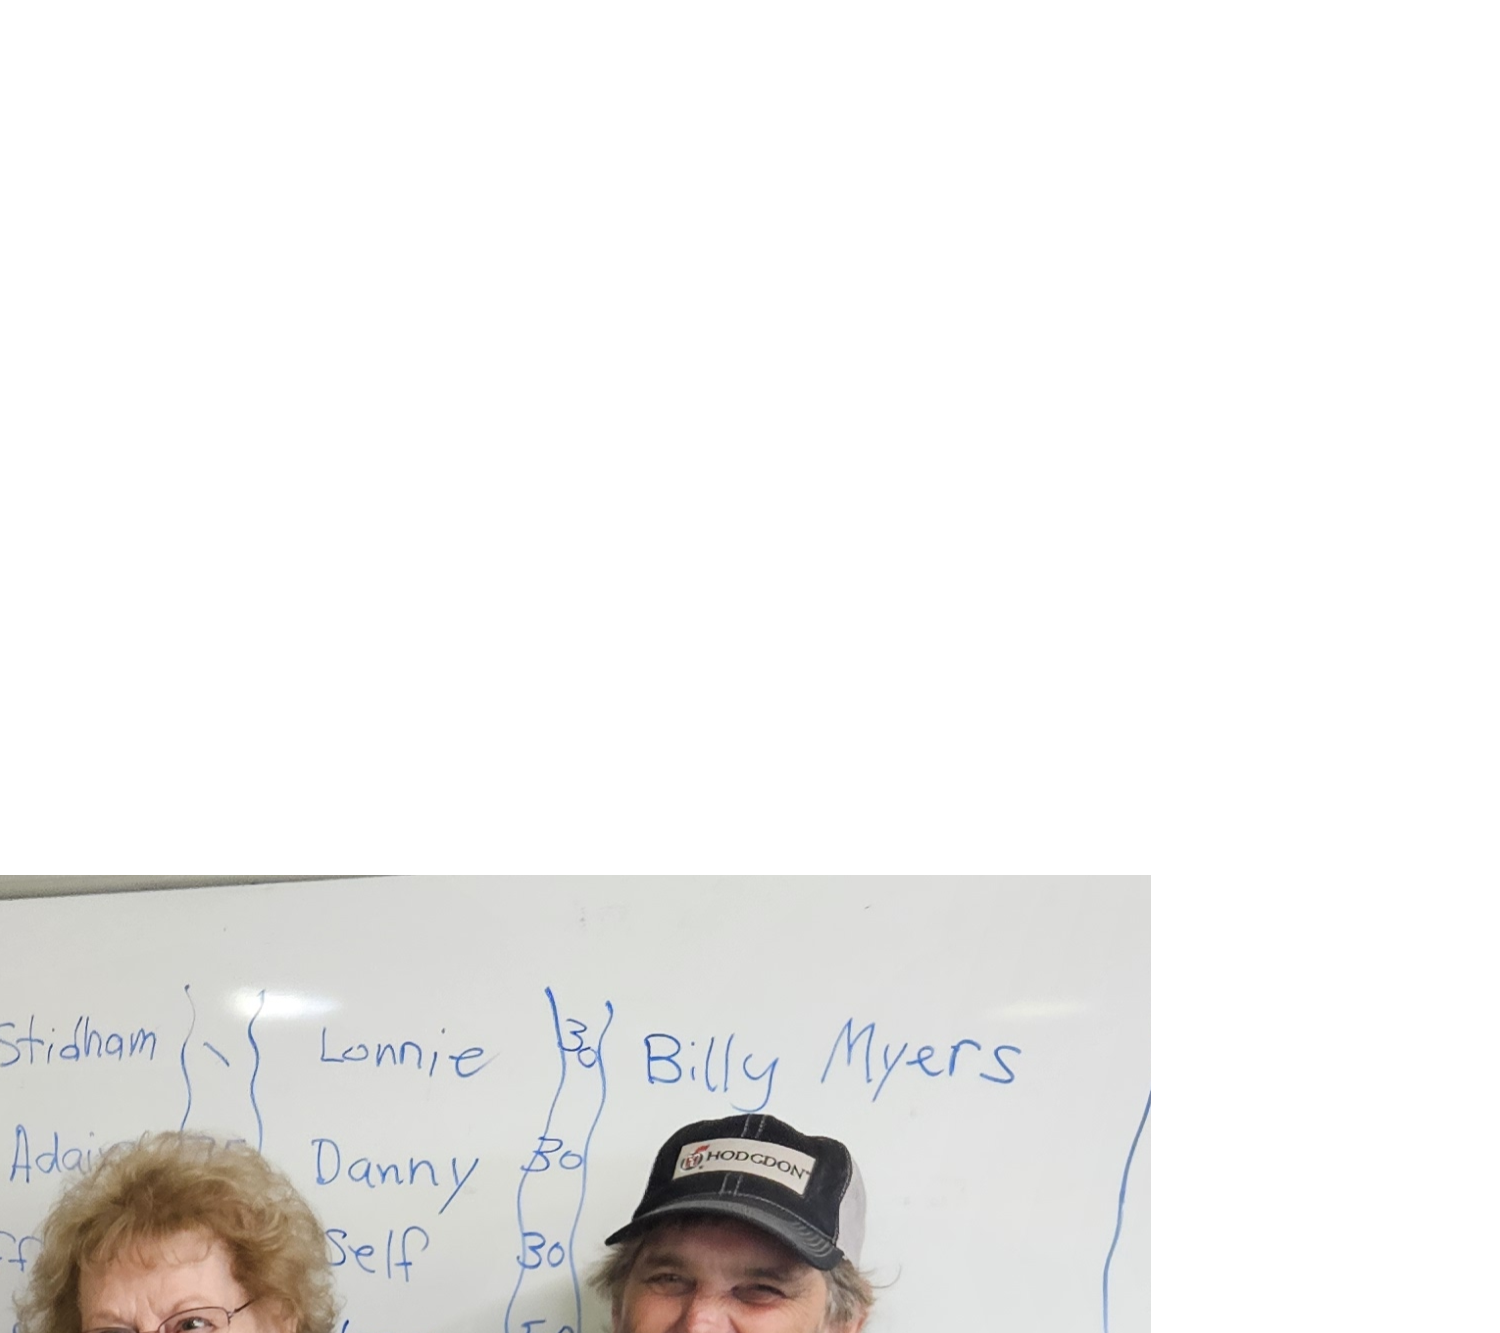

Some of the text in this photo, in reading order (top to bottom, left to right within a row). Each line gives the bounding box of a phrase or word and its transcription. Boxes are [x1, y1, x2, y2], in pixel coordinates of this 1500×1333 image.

[319, 1023, 500, 1079] Lonnie
[643, 1017, 1023, 1112] Billy Myers
[312, 1137, 480, 1214] Danny
[706, 1149, 805, 1180] HODGDON
[325, 1226, 430, 1285] Self
[517, 1233, 566, 1271] 30
